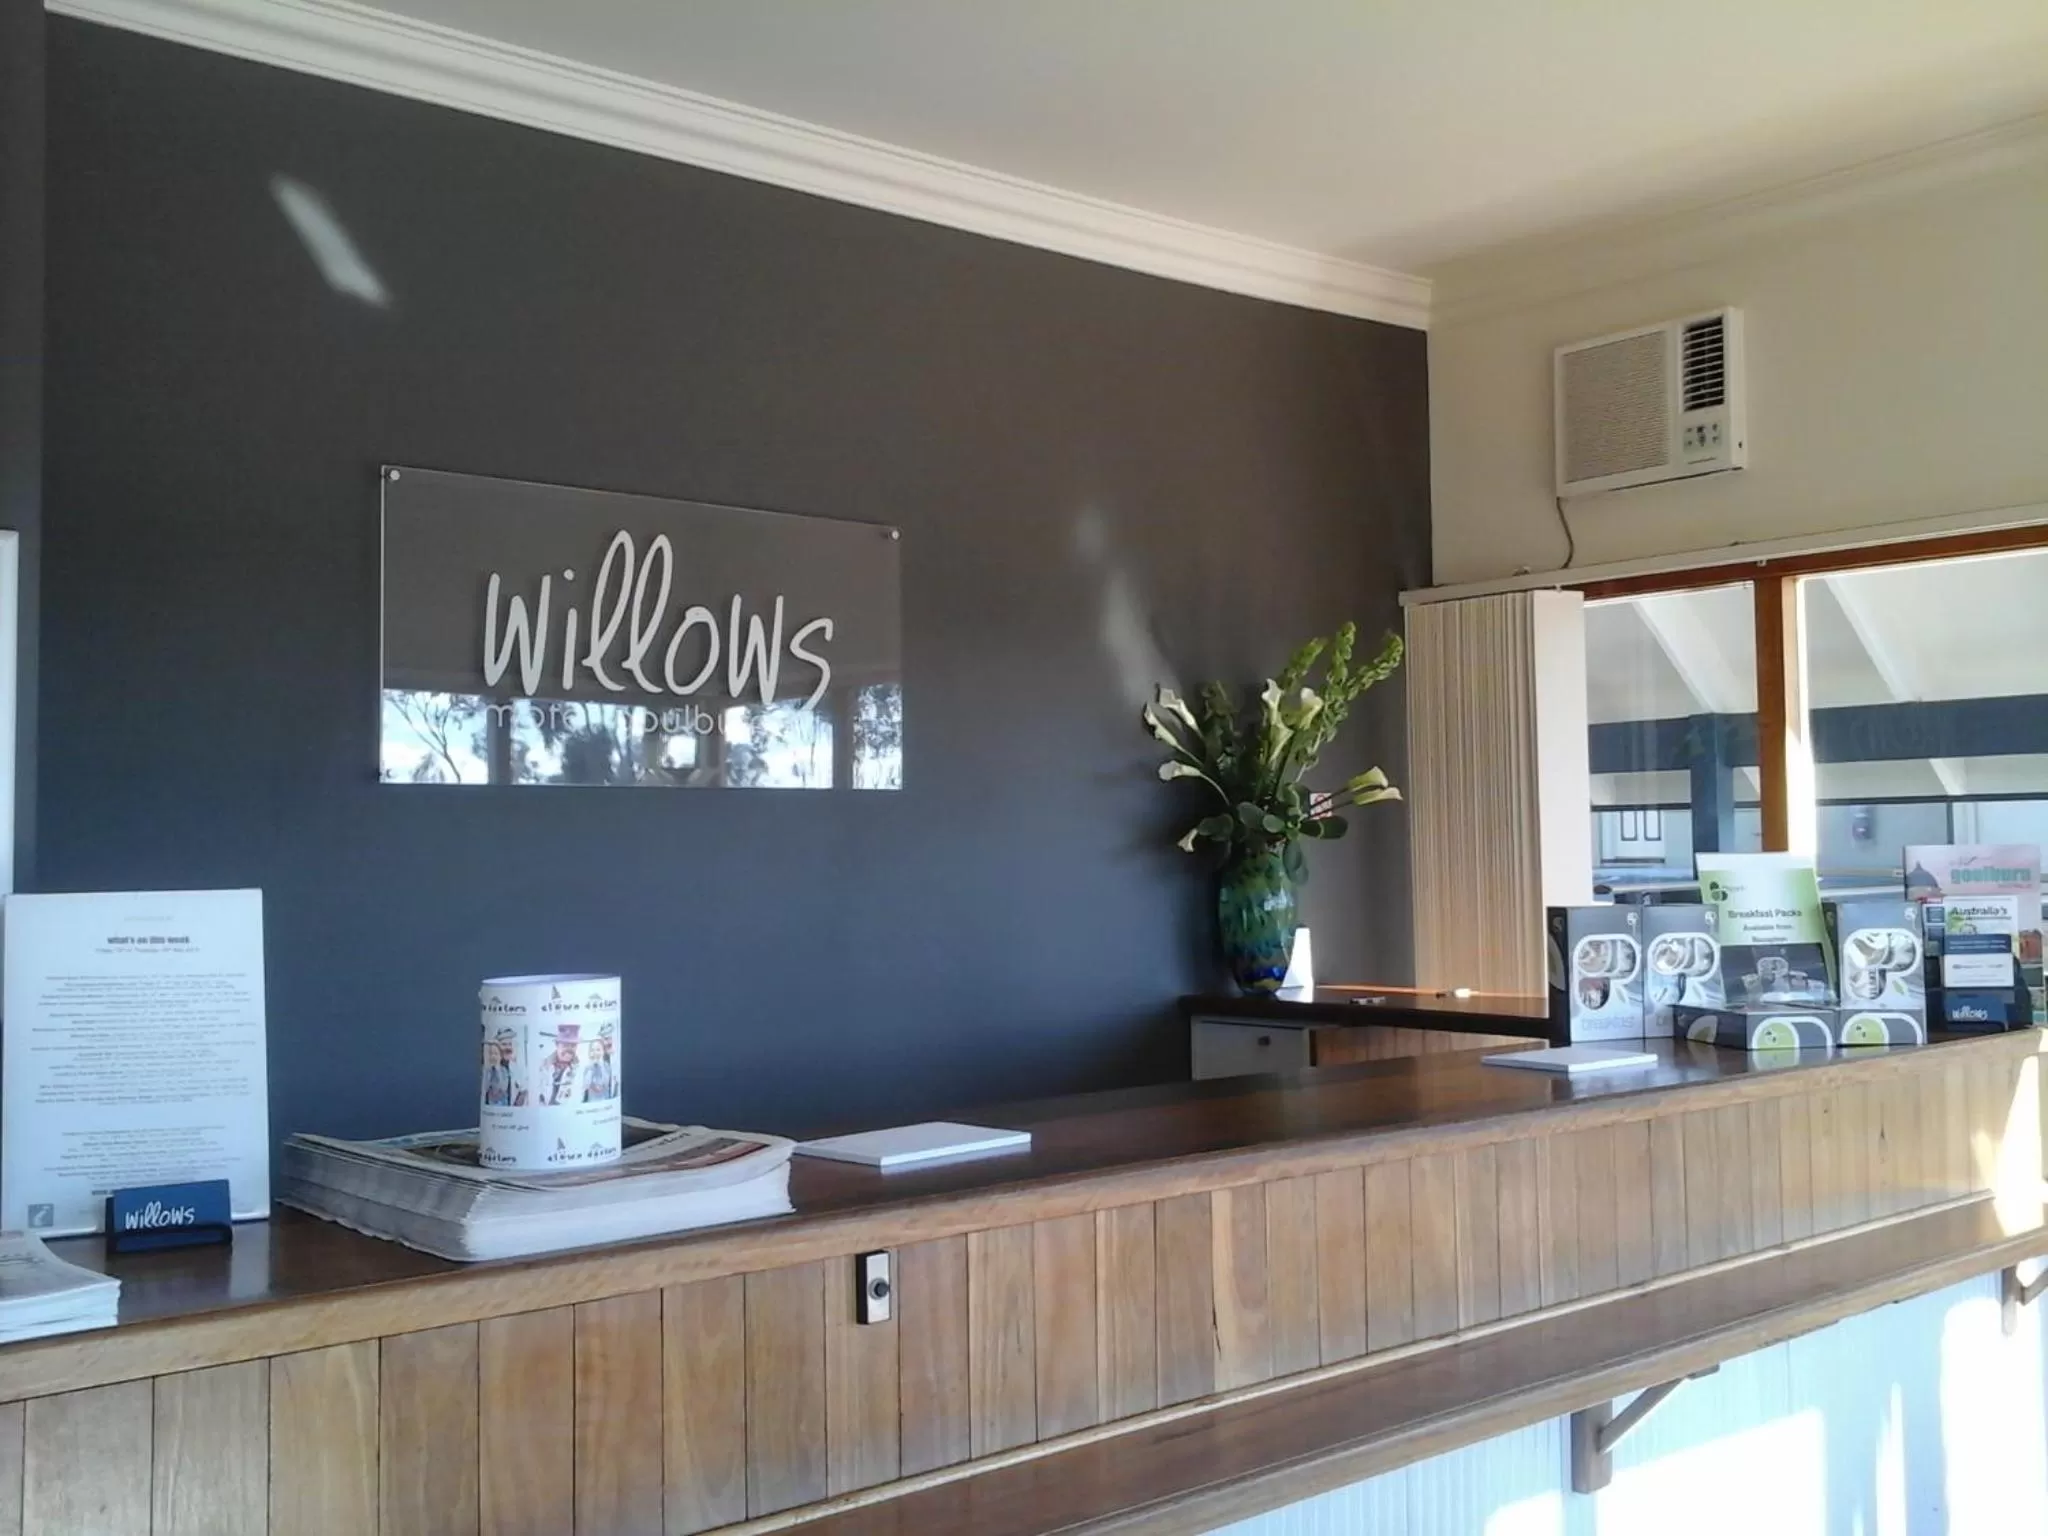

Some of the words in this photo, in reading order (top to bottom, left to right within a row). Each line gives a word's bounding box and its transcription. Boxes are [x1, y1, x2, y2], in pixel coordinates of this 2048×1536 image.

[484, 529, 834, 713] willows
[1727, 909, 1774, 919] Breakfast
[1775, 908, 1803, 918] Packs
[124, 1201, 196, 1230] willows
